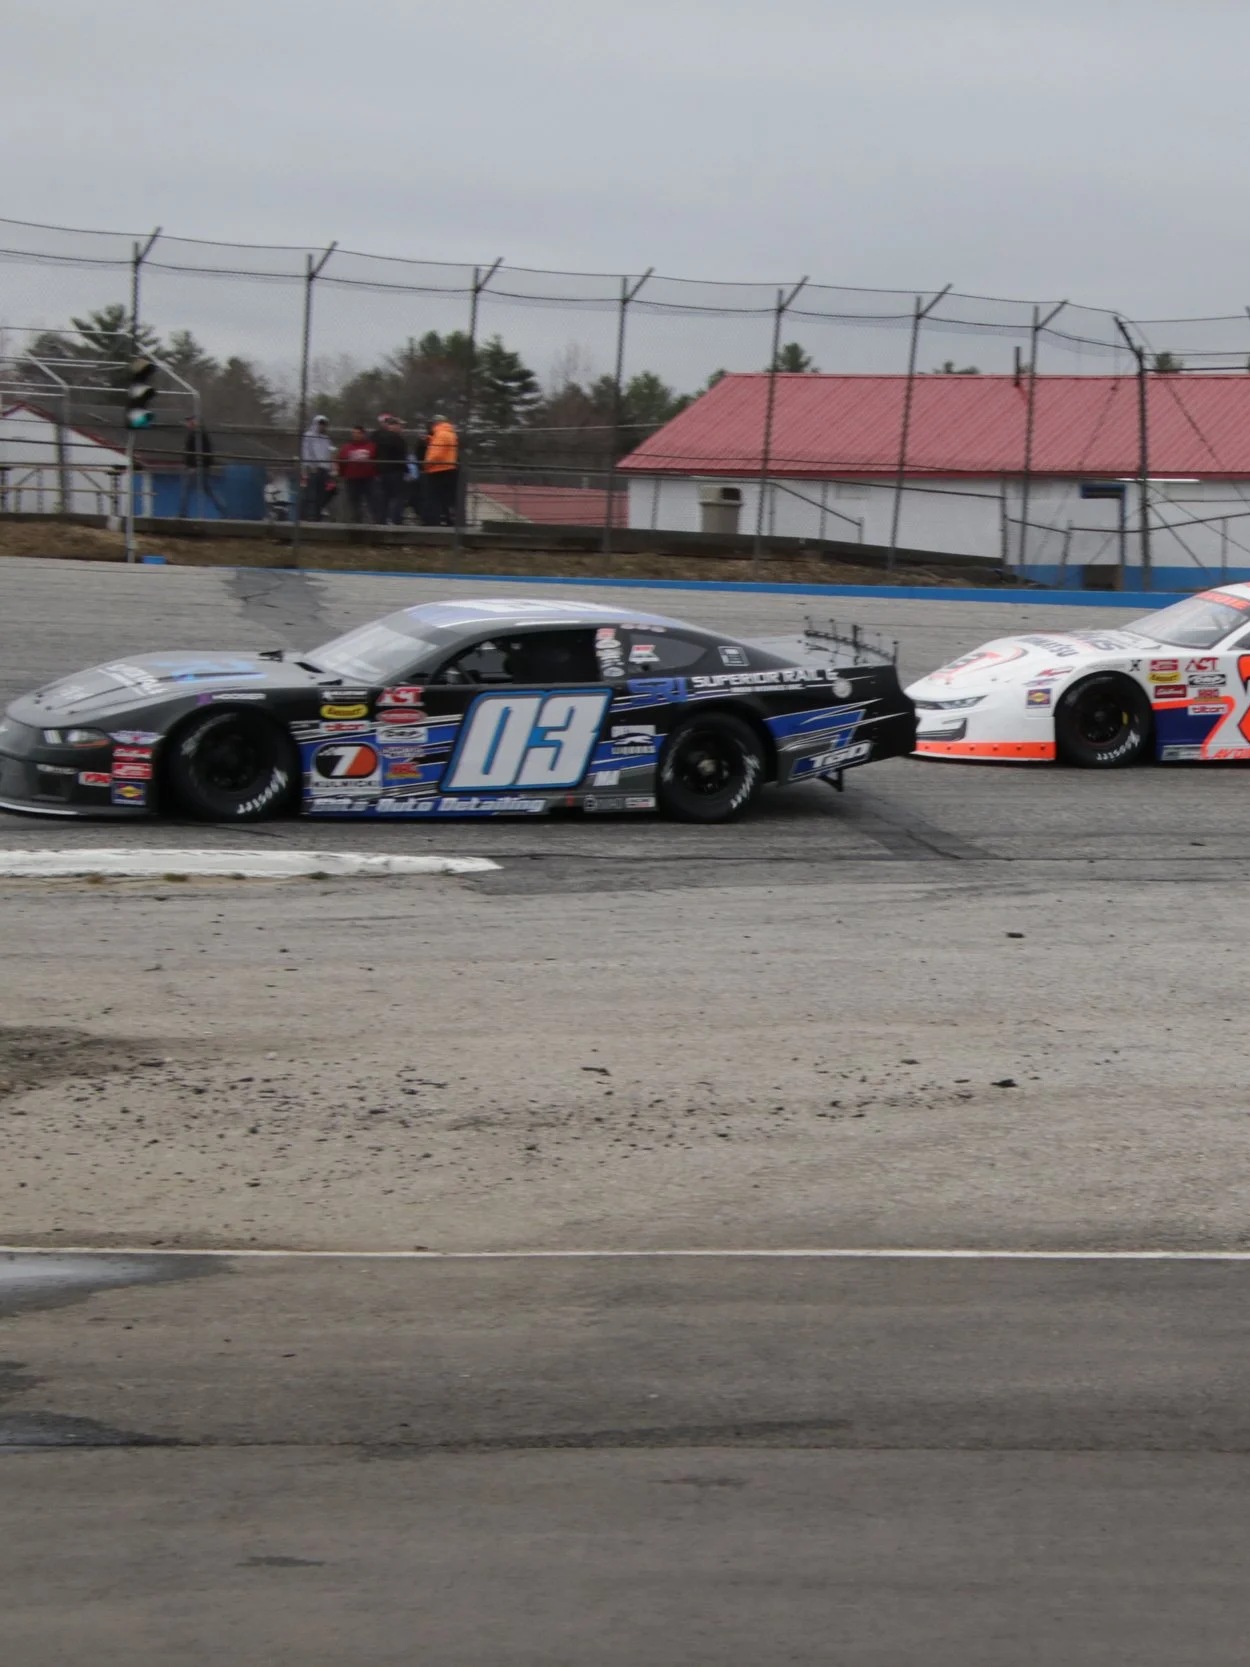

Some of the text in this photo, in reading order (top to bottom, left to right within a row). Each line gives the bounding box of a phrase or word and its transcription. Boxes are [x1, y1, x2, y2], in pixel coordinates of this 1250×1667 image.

[1185, 657, 1219, 672] ACT
[691, 671, 780, 688] SUPERIOR
[782, 668, 824, 683] RAIL
[441, 688, 613, 791] 03
